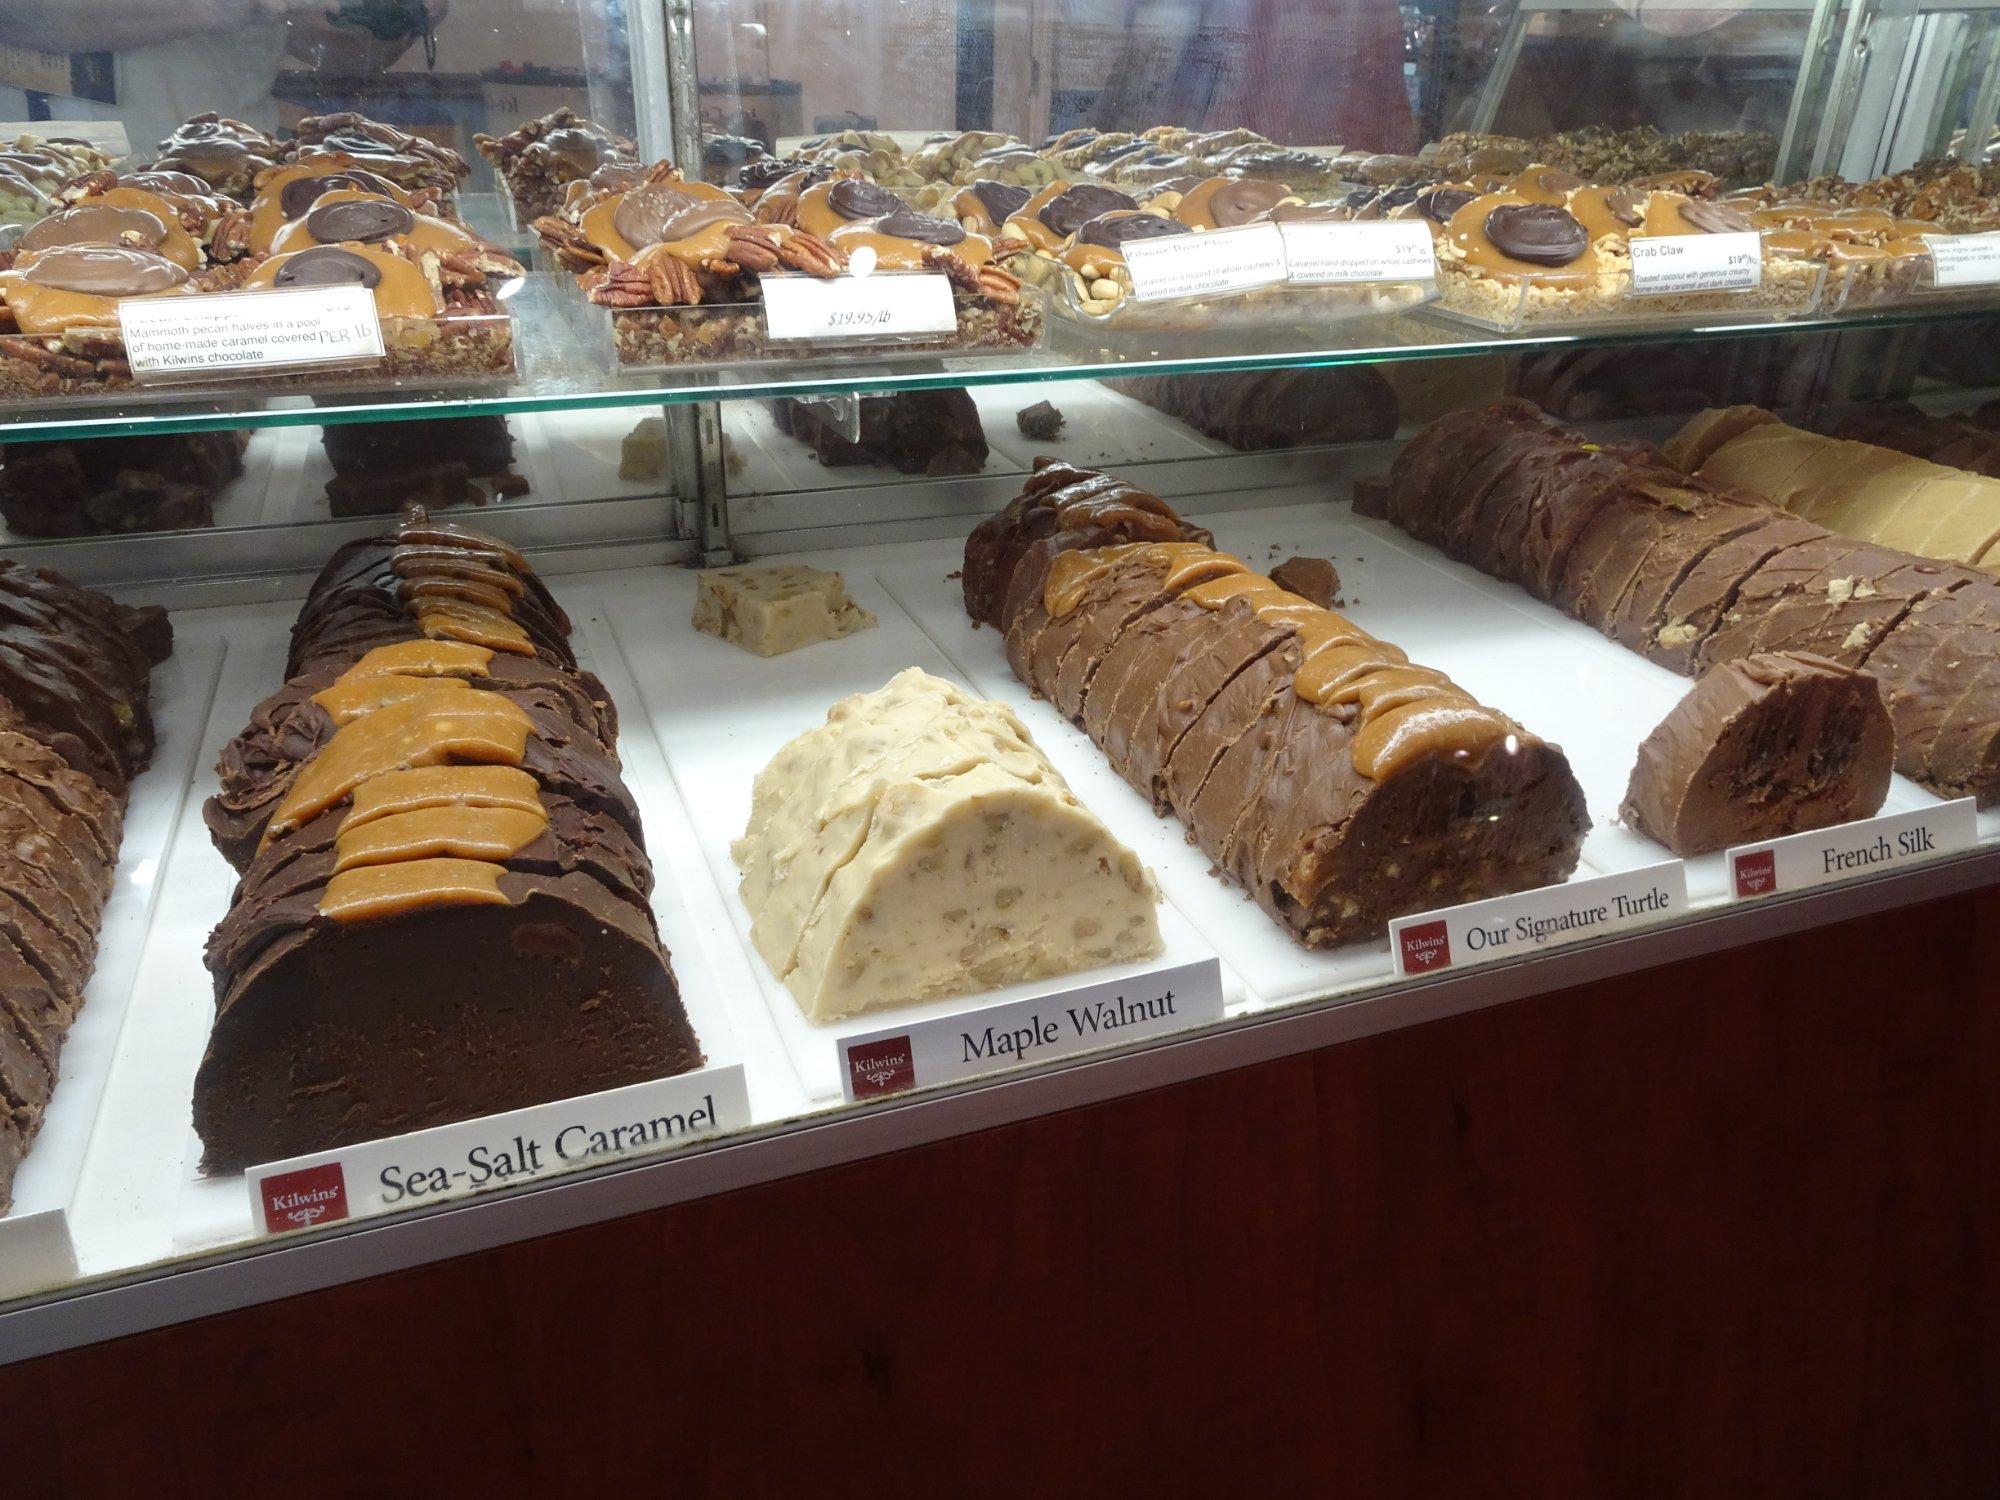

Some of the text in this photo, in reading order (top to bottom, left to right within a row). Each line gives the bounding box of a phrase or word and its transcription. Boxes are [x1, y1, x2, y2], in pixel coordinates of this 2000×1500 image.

[1633, 245, 1684, 257] Crab Claw
[1296, 270, 1325, 279] covered
[1334, 270, 1348, 278] milk
[1349, 269, 1384, 278] chocolate
[1686, 271, 1699, 279] with
[1709, 279, 1723, 287] dark
[1137, 278, 1230, 299] covered in dark chocolate
[828, 308, 891, 327] $19.95/lb
[129, 317, 321, 339] Mammoth pecan halves in a pool
[319, 328, 351, 344] PER
[132, 332, 317, 353] of home-made caramel covered
[135, 350, 264, 368] with Kilwins chocolate
[1822, 826, 1936, 874] French Silk
[1466, 887, 1670, 951] Our Signature Turtle
[960, 990, 1178, 1062] Maple Walnut
[379, 1094, 719, 1204] Sea-Salt Caramel
